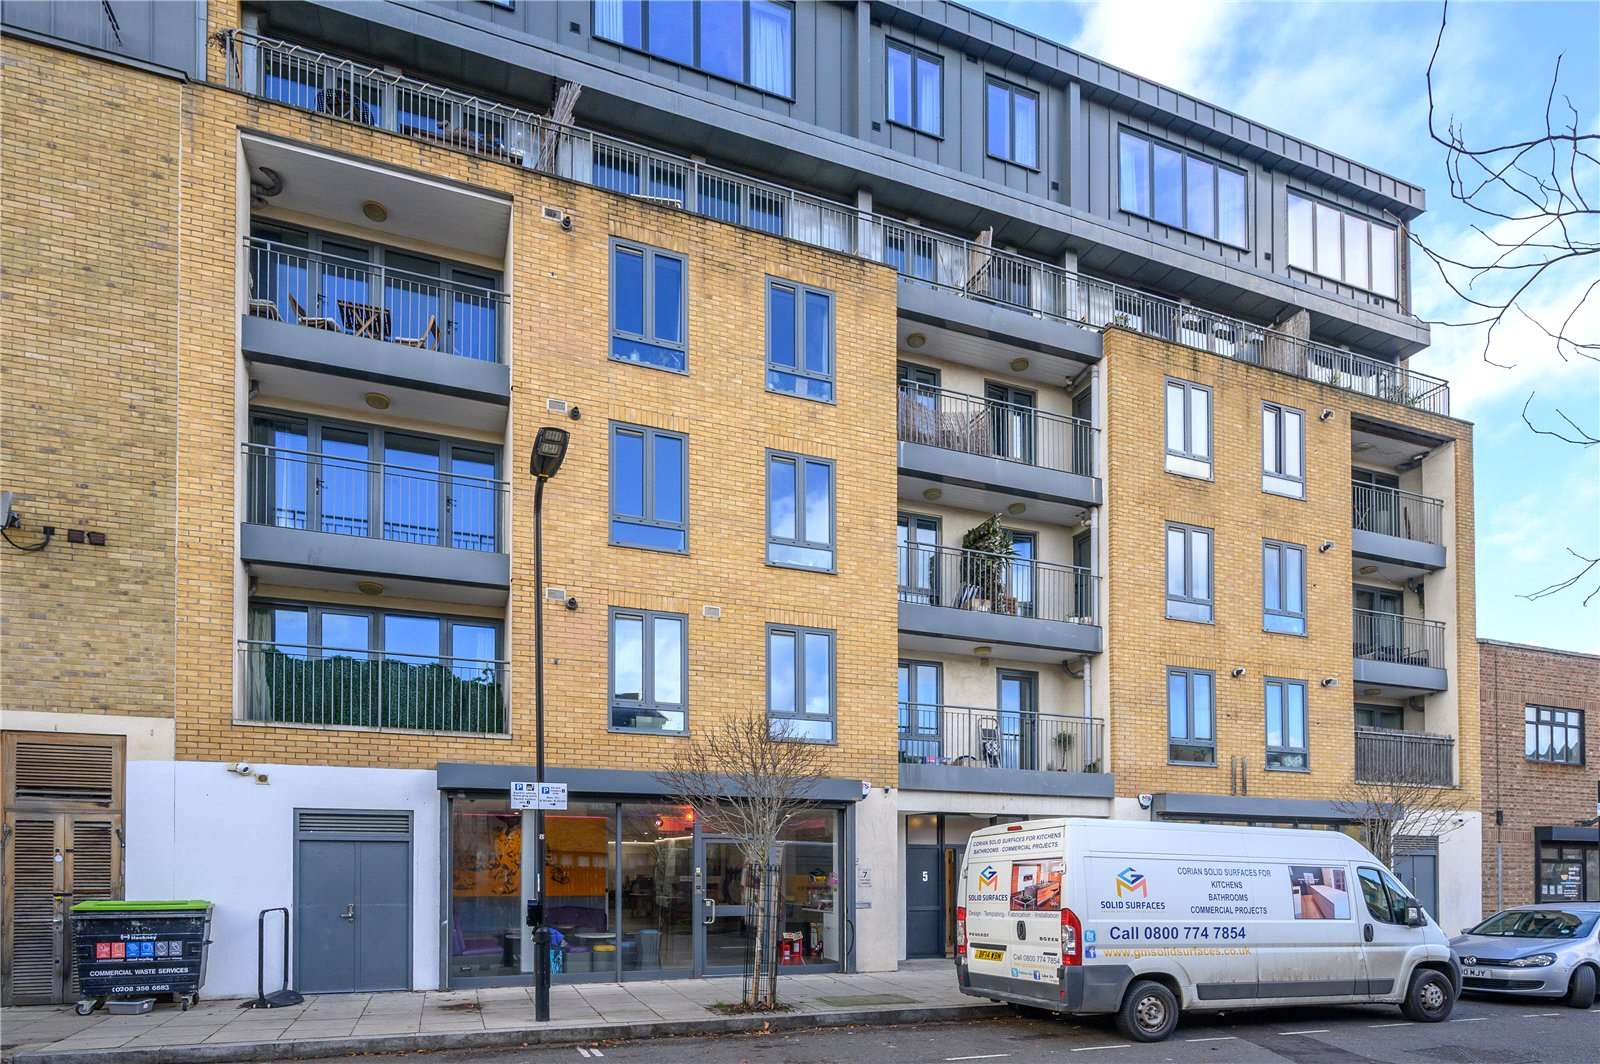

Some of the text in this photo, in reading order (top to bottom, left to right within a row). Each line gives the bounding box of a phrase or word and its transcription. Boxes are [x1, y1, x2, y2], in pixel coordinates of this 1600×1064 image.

[1002, 836, 1025, 844] SURFACES
[1036, 832, 1061, 840] KITCHENS
[1032, 842, 1059, 850] PROJECTS
[922, 871, 929, 882] 5
[1177, 867, 1272, 877] CORIAN SOLID SURFACES FOR
[1210, 881, 1243, 890] KITCHENS
[982, 894, 1008, 902] SURFACES
[1208, 893, 1249, 902] BATHROOMS
[1100, 900, 1166, 910] SOLID SURFACES
[1190, 906, 1268, 915] COMMERCIAL PROJECTS
[1110, 926, 1246, 940] Call 0800 774 7854
[1103, 946, 1252, 960] www.gmsolidsurfaces.co.uk
[90, 968, 133, 977] COMMERCIAL
